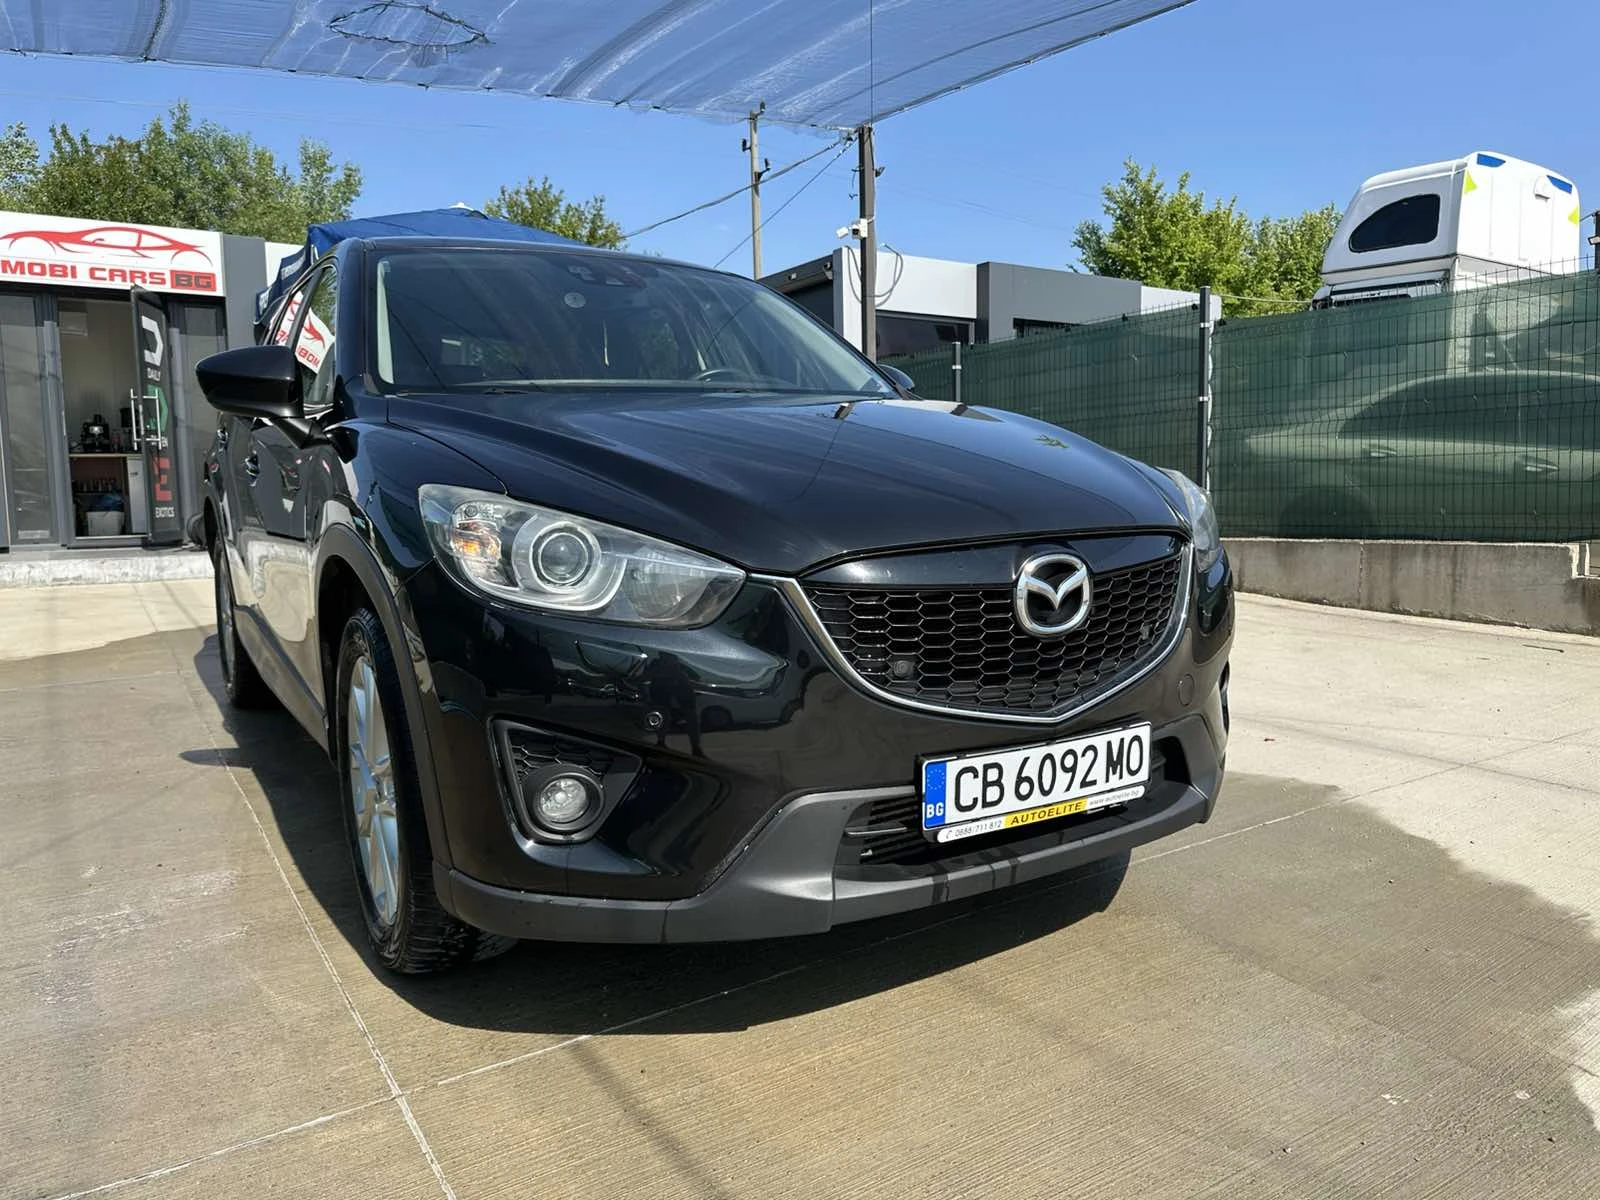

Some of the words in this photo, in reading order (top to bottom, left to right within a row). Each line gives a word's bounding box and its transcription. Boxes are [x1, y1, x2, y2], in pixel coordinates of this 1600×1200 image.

[1, 259, 78, 280] MOBI
[89, 266, 166, 286] CARS
[174, 273, 212, 289] BG
[954, 762, 1005, 813] CB
[1014, 744, 1099, 801] 6092
[1105, 734, 1144, 783] MO
[926, 802, 944, 819] BG
[1010, 801, 1082, 826] AUTOELITE
